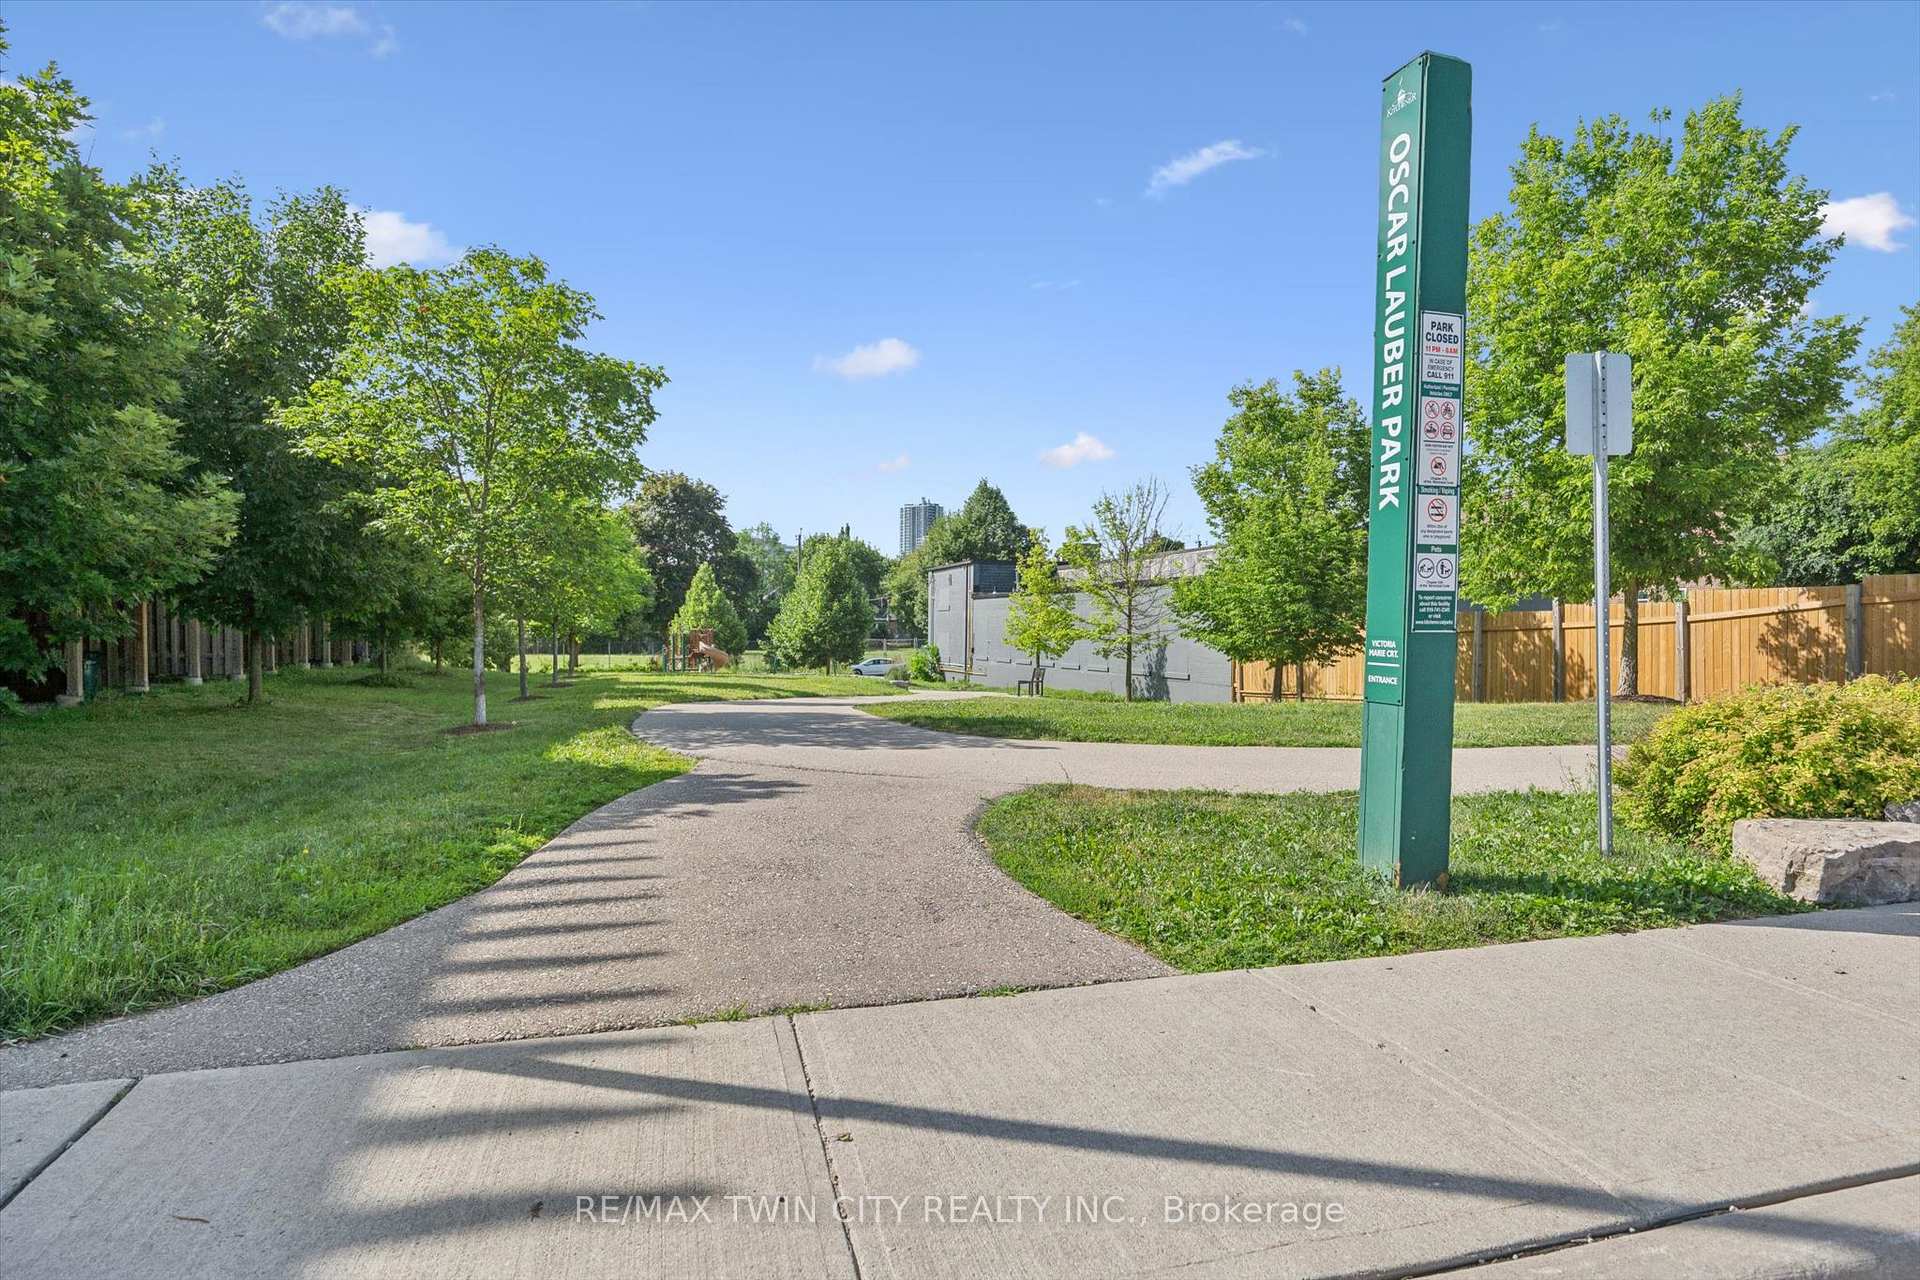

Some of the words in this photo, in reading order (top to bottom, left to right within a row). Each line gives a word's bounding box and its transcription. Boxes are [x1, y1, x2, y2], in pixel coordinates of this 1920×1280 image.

[1386, 132, 1411, 263] OSCAR
[1431, 321, 1453, 332] PARK
[1382, 265, 1407, 411] LAUBER
[1426, 332, 1458, 344] CLOSED
[1431, 345, 1441, 353] PM
[1426, 370, 1442, 378] CALL
[1444, 372, 1455, 380] 911
[1378, 415, 1403, 512] PARK
[1372, 640, 1396, 648] VICTORIA
[1368, 648, 1386, 657] MARIE
[1368, 674, 1398, 685] ENTRANCE
